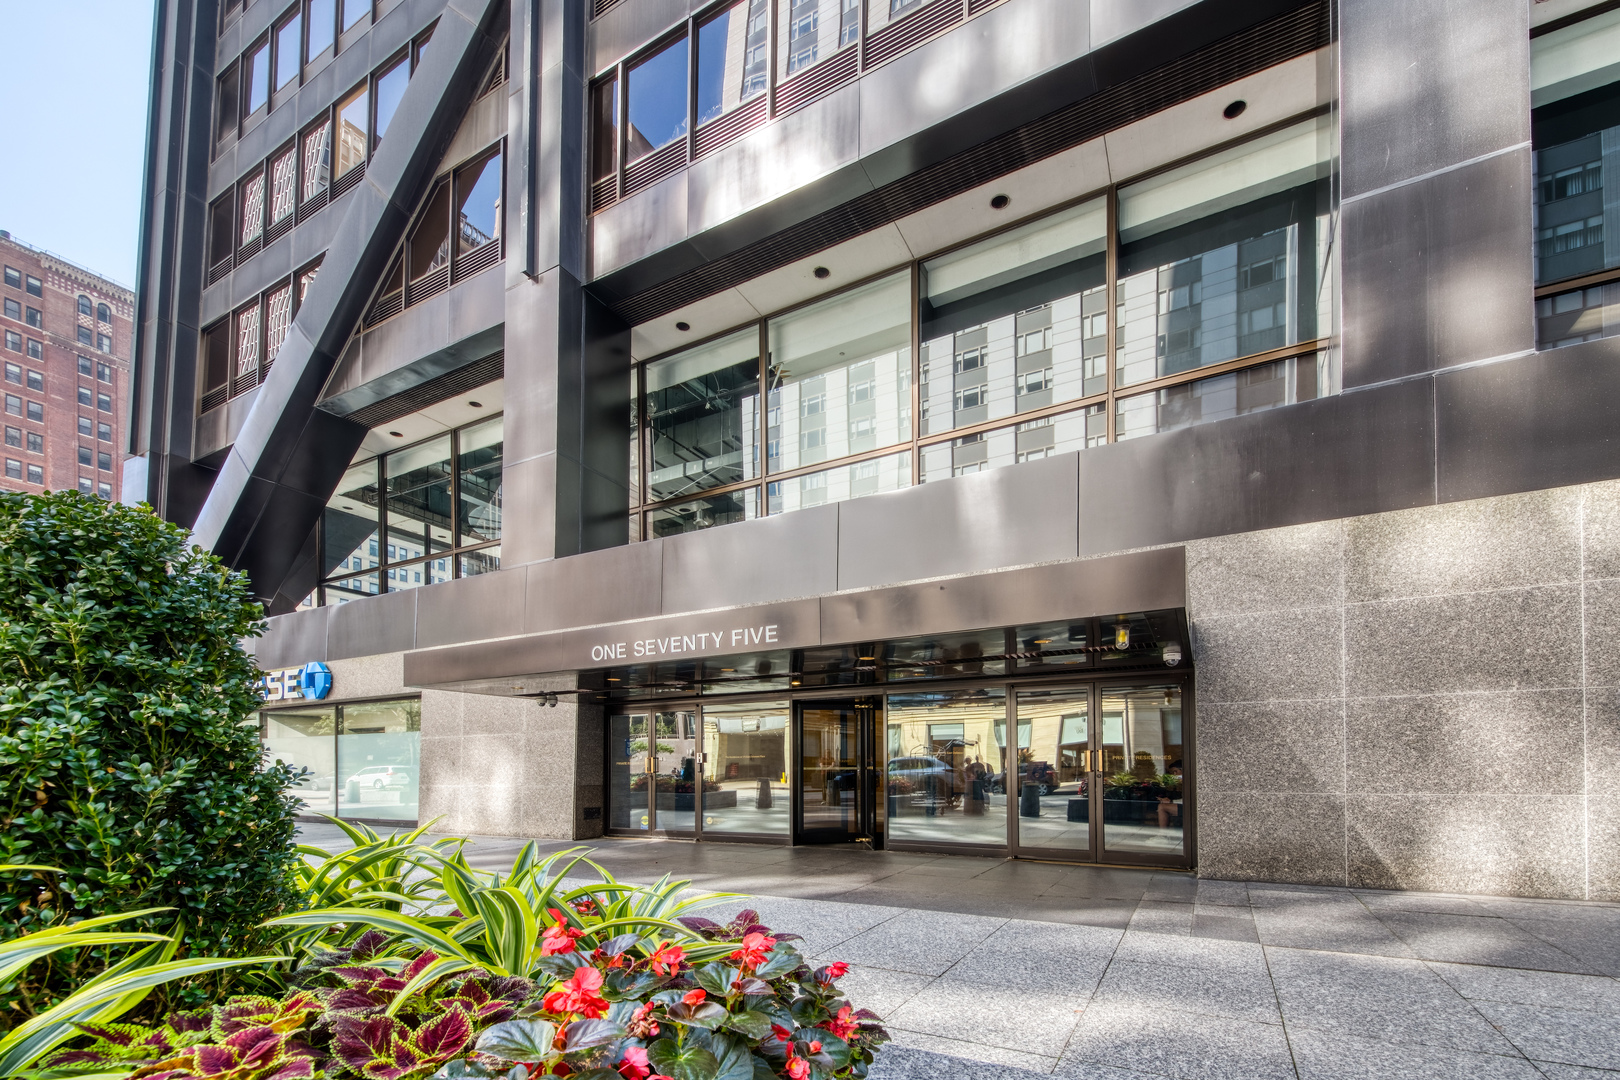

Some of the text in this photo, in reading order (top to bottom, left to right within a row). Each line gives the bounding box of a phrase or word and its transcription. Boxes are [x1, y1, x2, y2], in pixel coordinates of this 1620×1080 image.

[591, 625, 778, 662] ONE SEVENTY FIVE
[254, 669, 301, 701] SE
